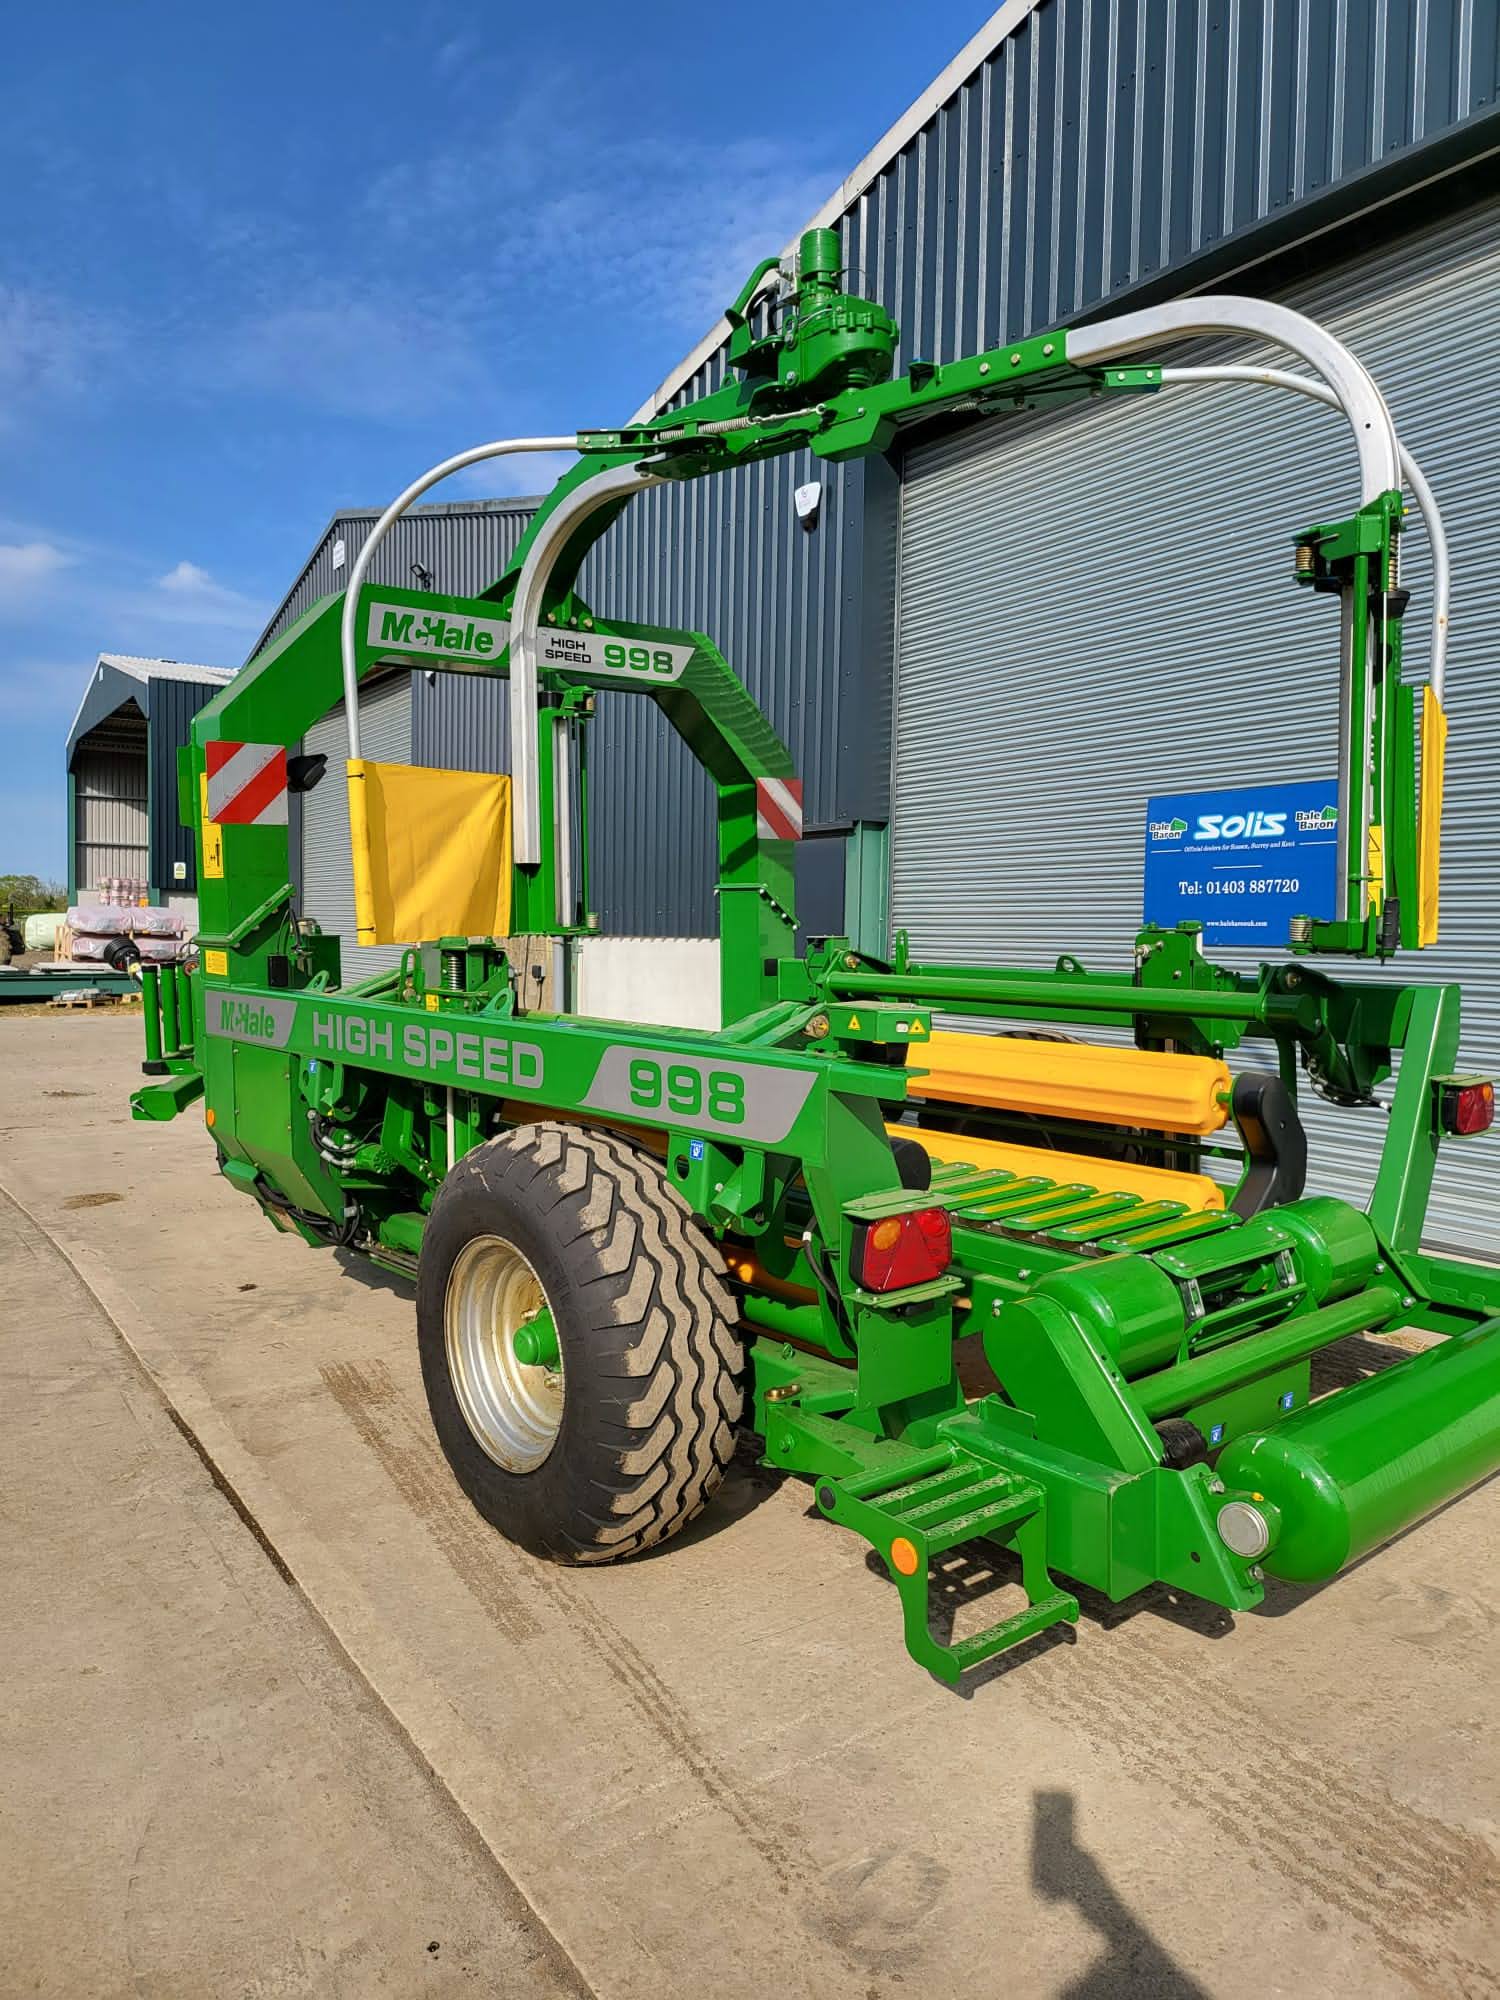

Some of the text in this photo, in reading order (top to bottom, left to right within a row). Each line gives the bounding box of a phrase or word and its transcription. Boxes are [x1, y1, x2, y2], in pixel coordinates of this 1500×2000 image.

[381, 611, 494, 653] McHale
[551, 637, 586, 651] HIGH
[545, 649, 592, 664] SPEED
[604, 644, 673, 674] 998
[1296, 811, 1321, 822] Bale
[1150, 823, 1170, 832] Bale
[1299, 820, 1334, 830] Baron
[1153, 831, 1181, 840] Baron
[1251, 842, 1269, 851] Surrey
[1270, 841, 1281, 849] and
[1179, 879, 1299, 895] Tel: 01403 887720
[220, 999, 275, 1039] McHale
[312, 1011, 545, 1089] HIGH SPEED
[629, 1060, 745, 1123] 998
